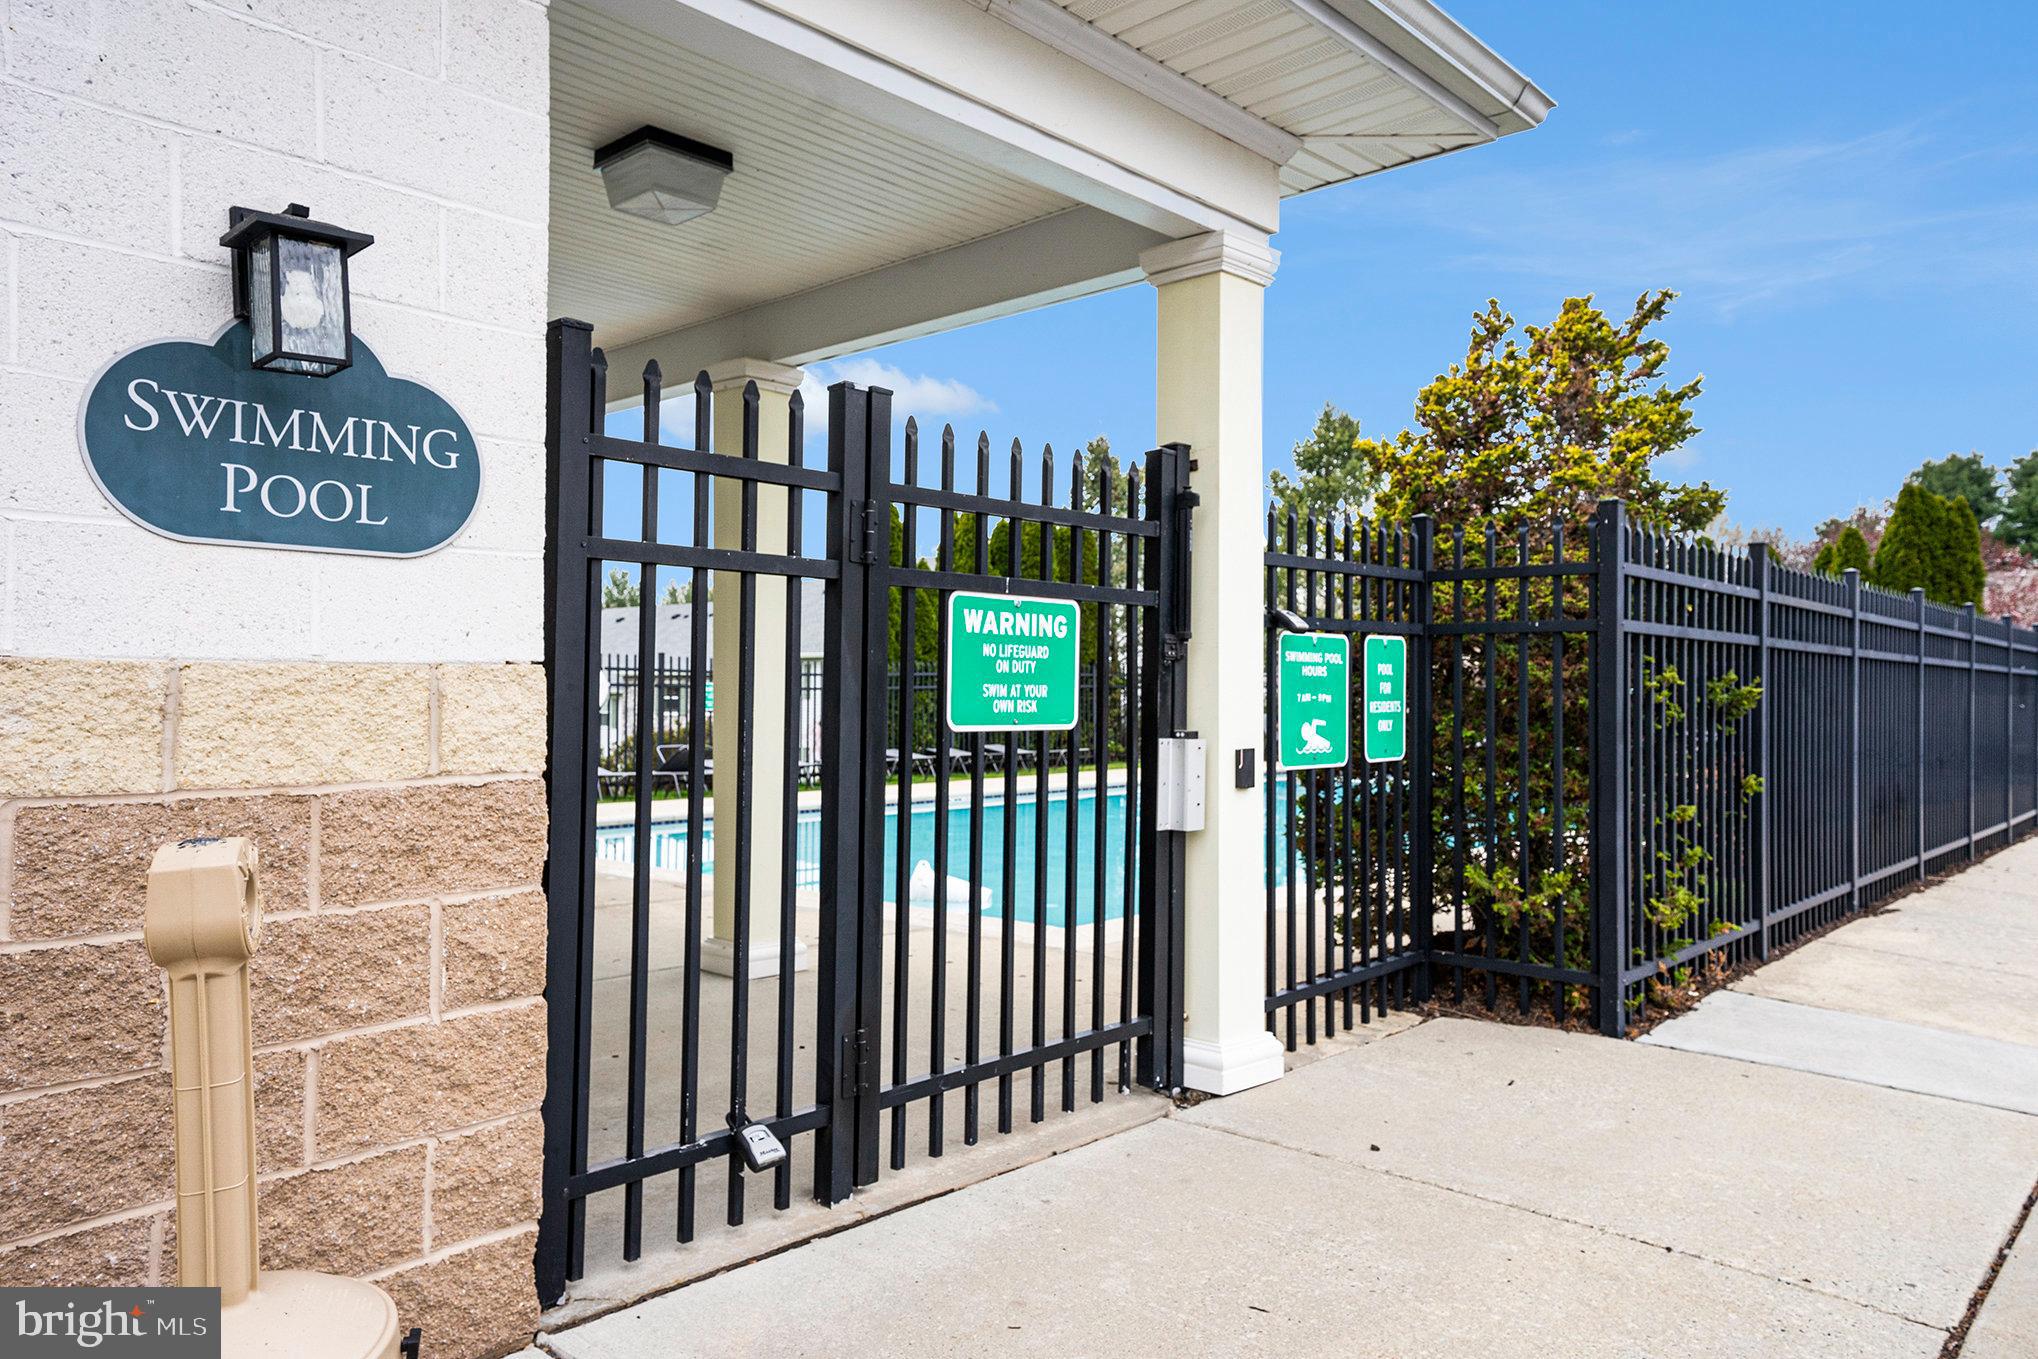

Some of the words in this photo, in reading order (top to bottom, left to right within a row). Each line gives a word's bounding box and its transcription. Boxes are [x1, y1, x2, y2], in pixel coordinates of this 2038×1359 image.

[124, 378, 460, 469] SWIMMING
[220, 462, 388, 525] POOL
[963, 608, 1068, 639] WARNING
[983, 643, 997, 657] NO
[999, 644, 1050, 659] LIFEGUARD
[1285, 650, 1323, 663] SWIMMING
[1324, 652, 1343, 665] POOL
[995, 659, 1009, 673] ON
[1012, 660, 1037, 674] DUTY
[1301, 665, 1327, 677] HOURS
[1377, 663, 1393, 676] POOL
[982, 683, 1007, 698] SWIM
[1010, 684, 1020, 698] AT
[1023, 684, 1048, 698] YOUR
[993, 699, 1014, 713] OWN
[1017, 699, 1038, 713] RISK
